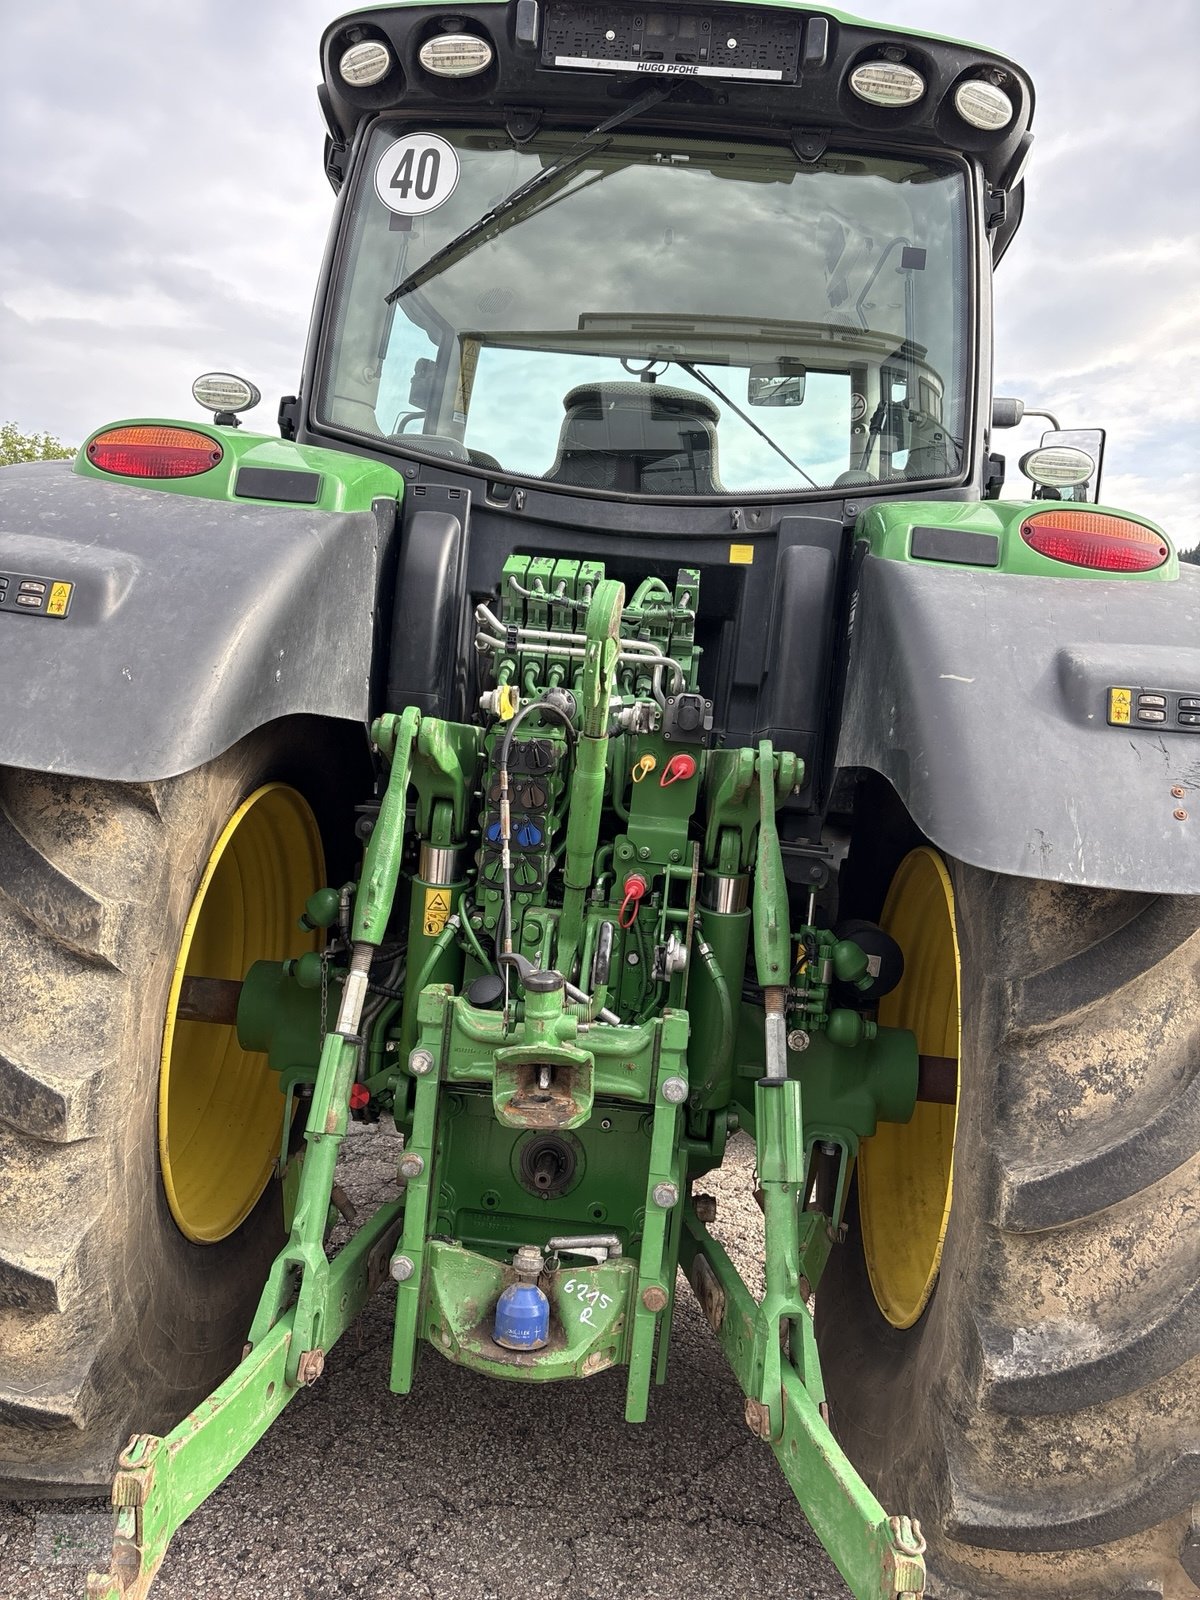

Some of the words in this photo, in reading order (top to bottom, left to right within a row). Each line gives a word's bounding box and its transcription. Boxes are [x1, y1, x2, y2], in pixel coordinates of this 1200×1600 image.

[637, 62, 665, 72] HUGO
[667, 64, 699, 75] PFOHE
[389, 148, 440, 200] 40
[563, 1279, 613, 1309] 6215
[580, 1307, 598, 1328] R
